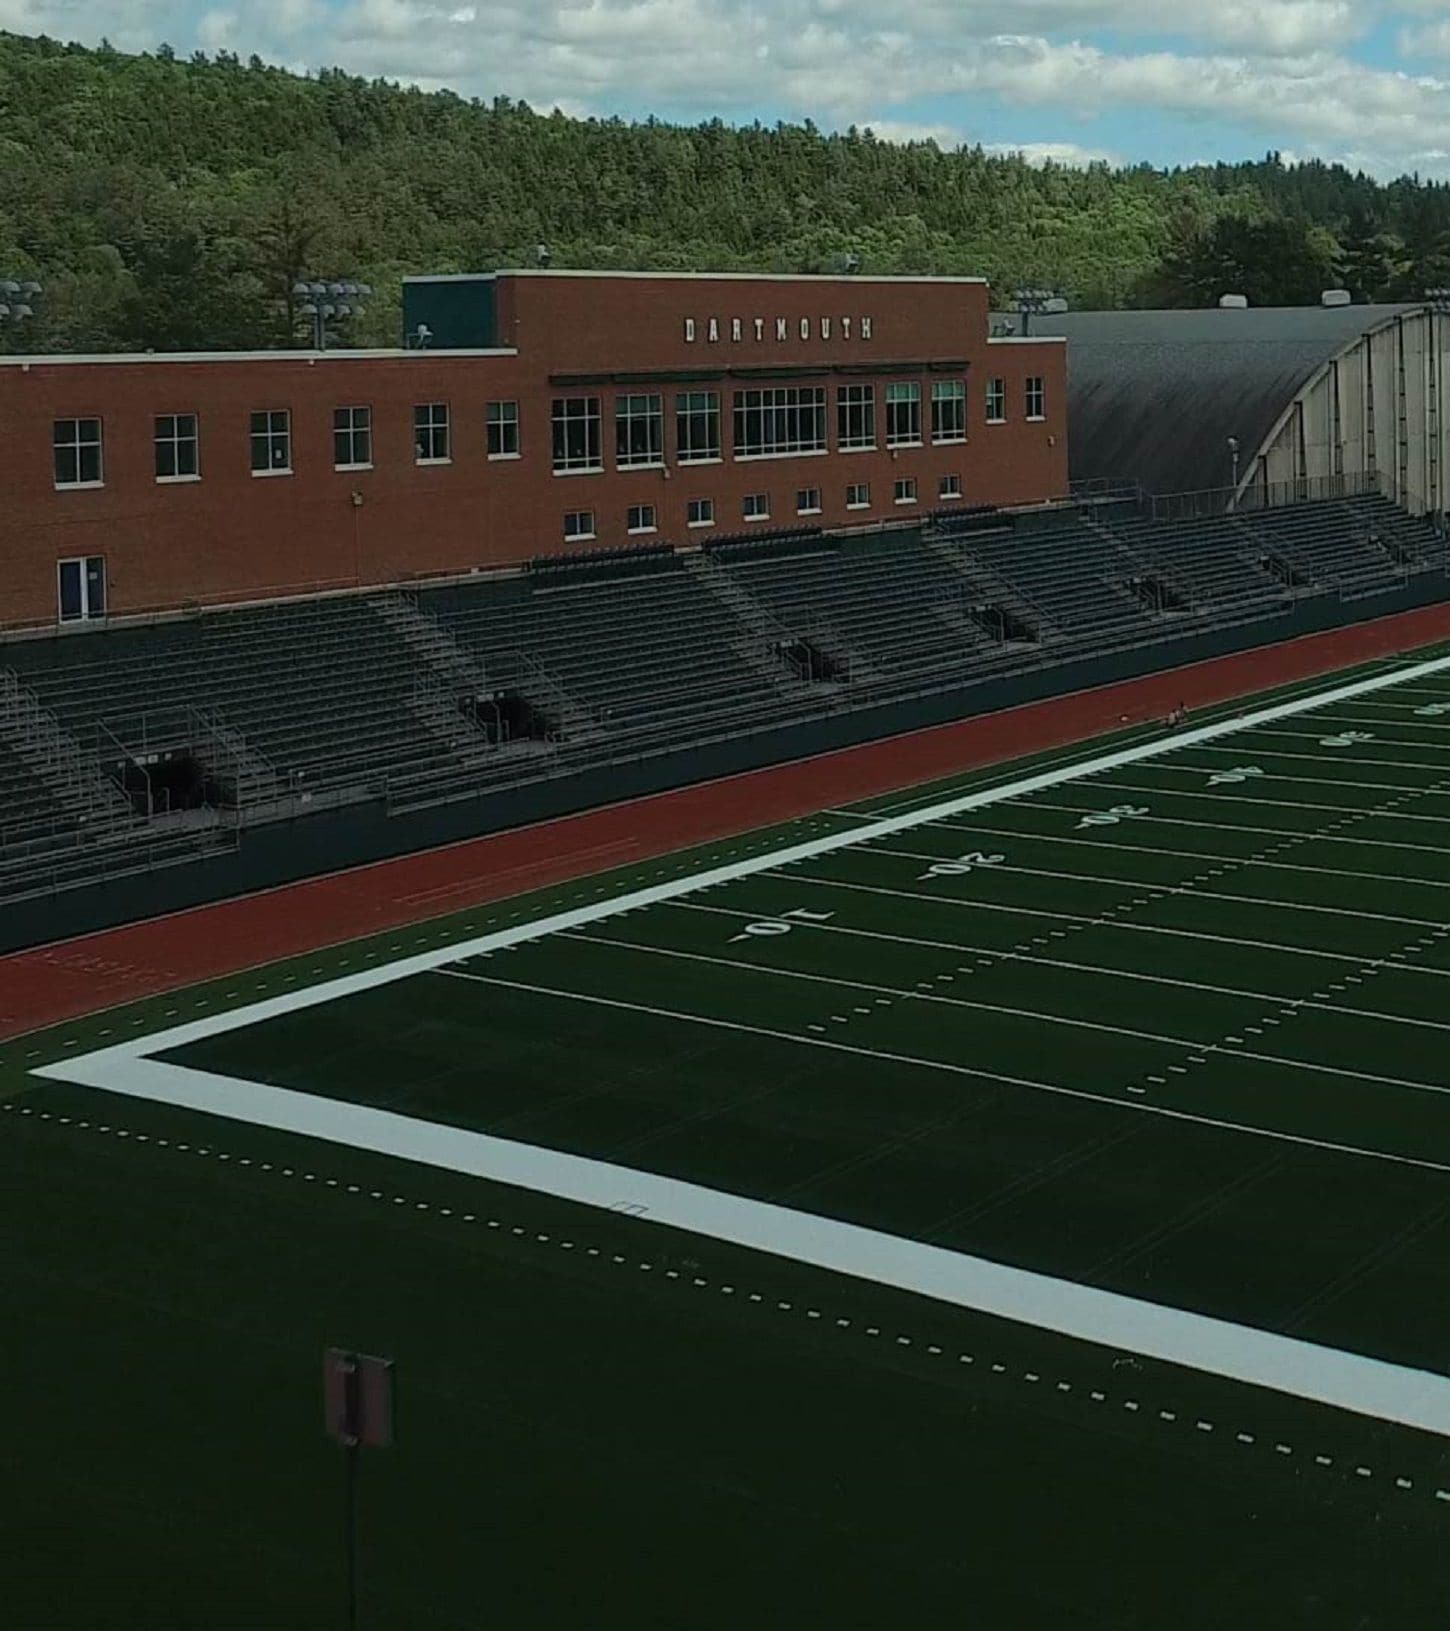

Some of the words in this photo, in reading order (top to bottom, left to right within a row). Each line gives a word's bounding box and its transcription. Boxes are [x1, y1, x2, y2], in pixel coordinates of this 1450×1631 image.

[685, 318, 872, 342] DARTMOUTH
[929, 851, 1005, 875] 20
[745, 906, 836, 936] 10
